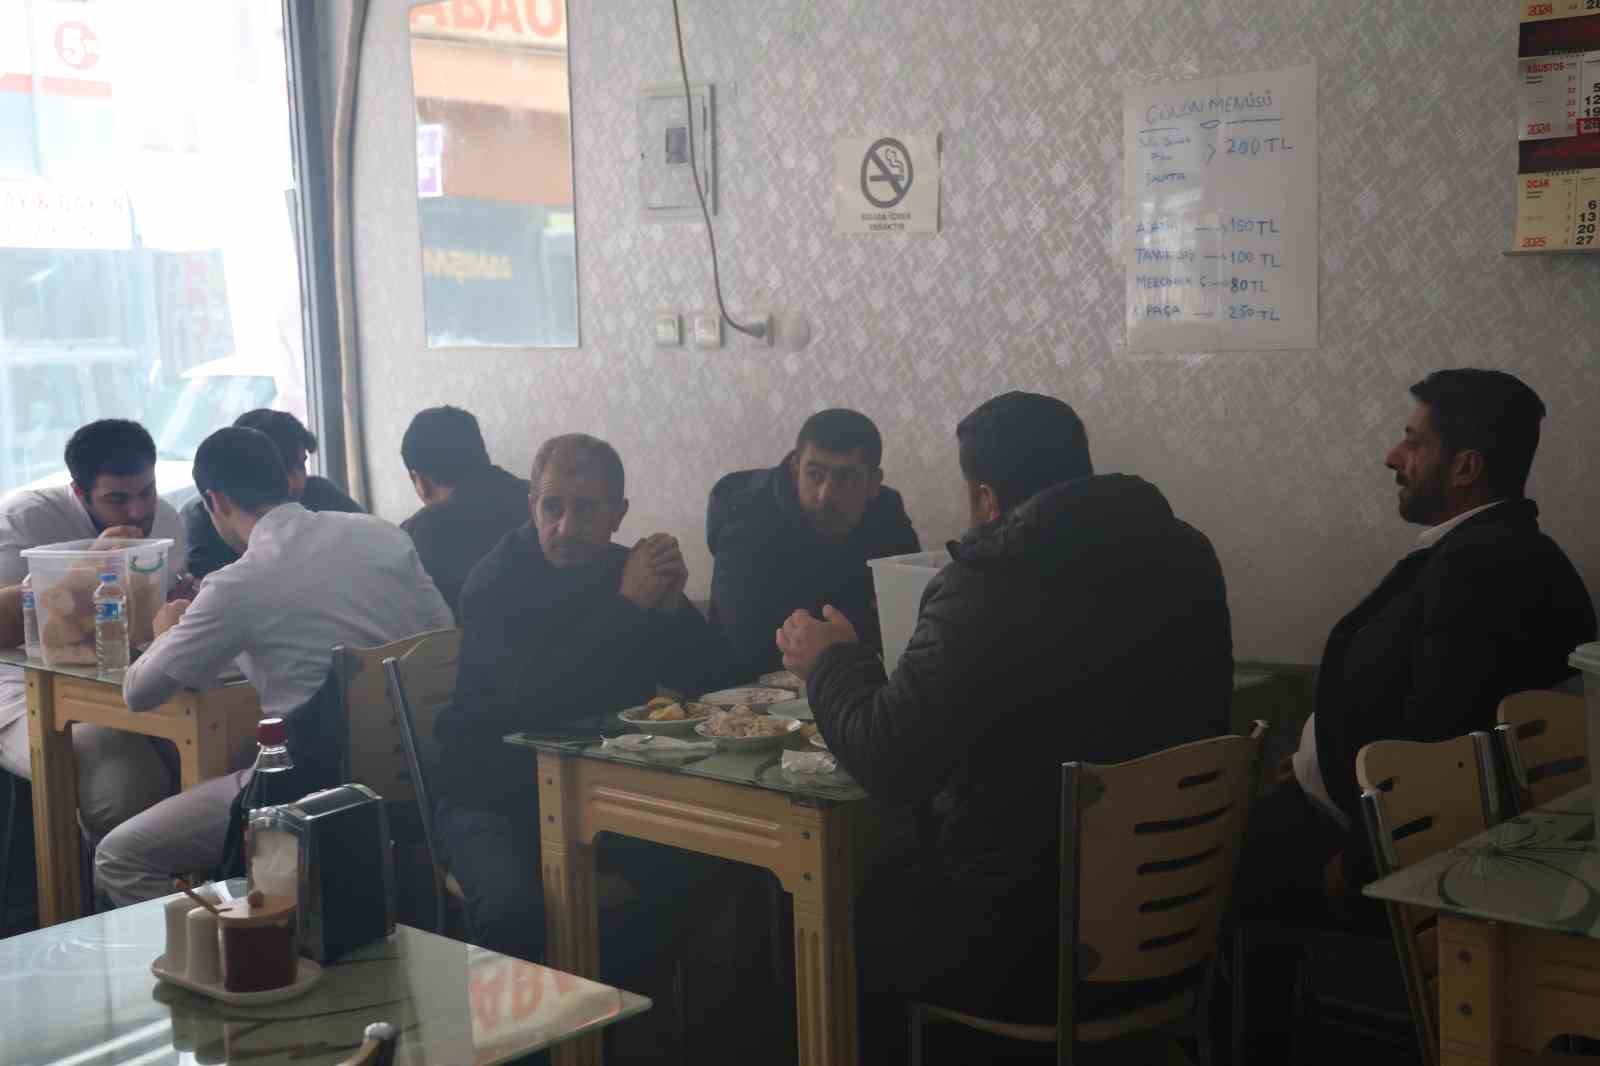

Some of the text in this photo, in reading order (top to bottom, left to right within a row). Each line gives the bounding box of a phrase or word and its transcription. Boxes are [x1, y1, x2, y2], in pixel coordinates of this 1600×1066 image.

[1224, 137, 1293, 156] 200 TL
[1588, 200, 1598, 210] 6
[1580, 212, 1597, 223] 13
[1256, 218, 1280, 236] TL
[1577, 224, 1596, 234] 20
[1576, 235, 1595, 246] 27
[1231, 250, 1256, 264] 100
[1260, 253, 1281, 268] TL
[1230, 278, 1248, 294] 80
[1249, 280, 1269, 294] TL
[1228, 304, 1255, 320] 250
[1256, 307, 1281, 322] TL
